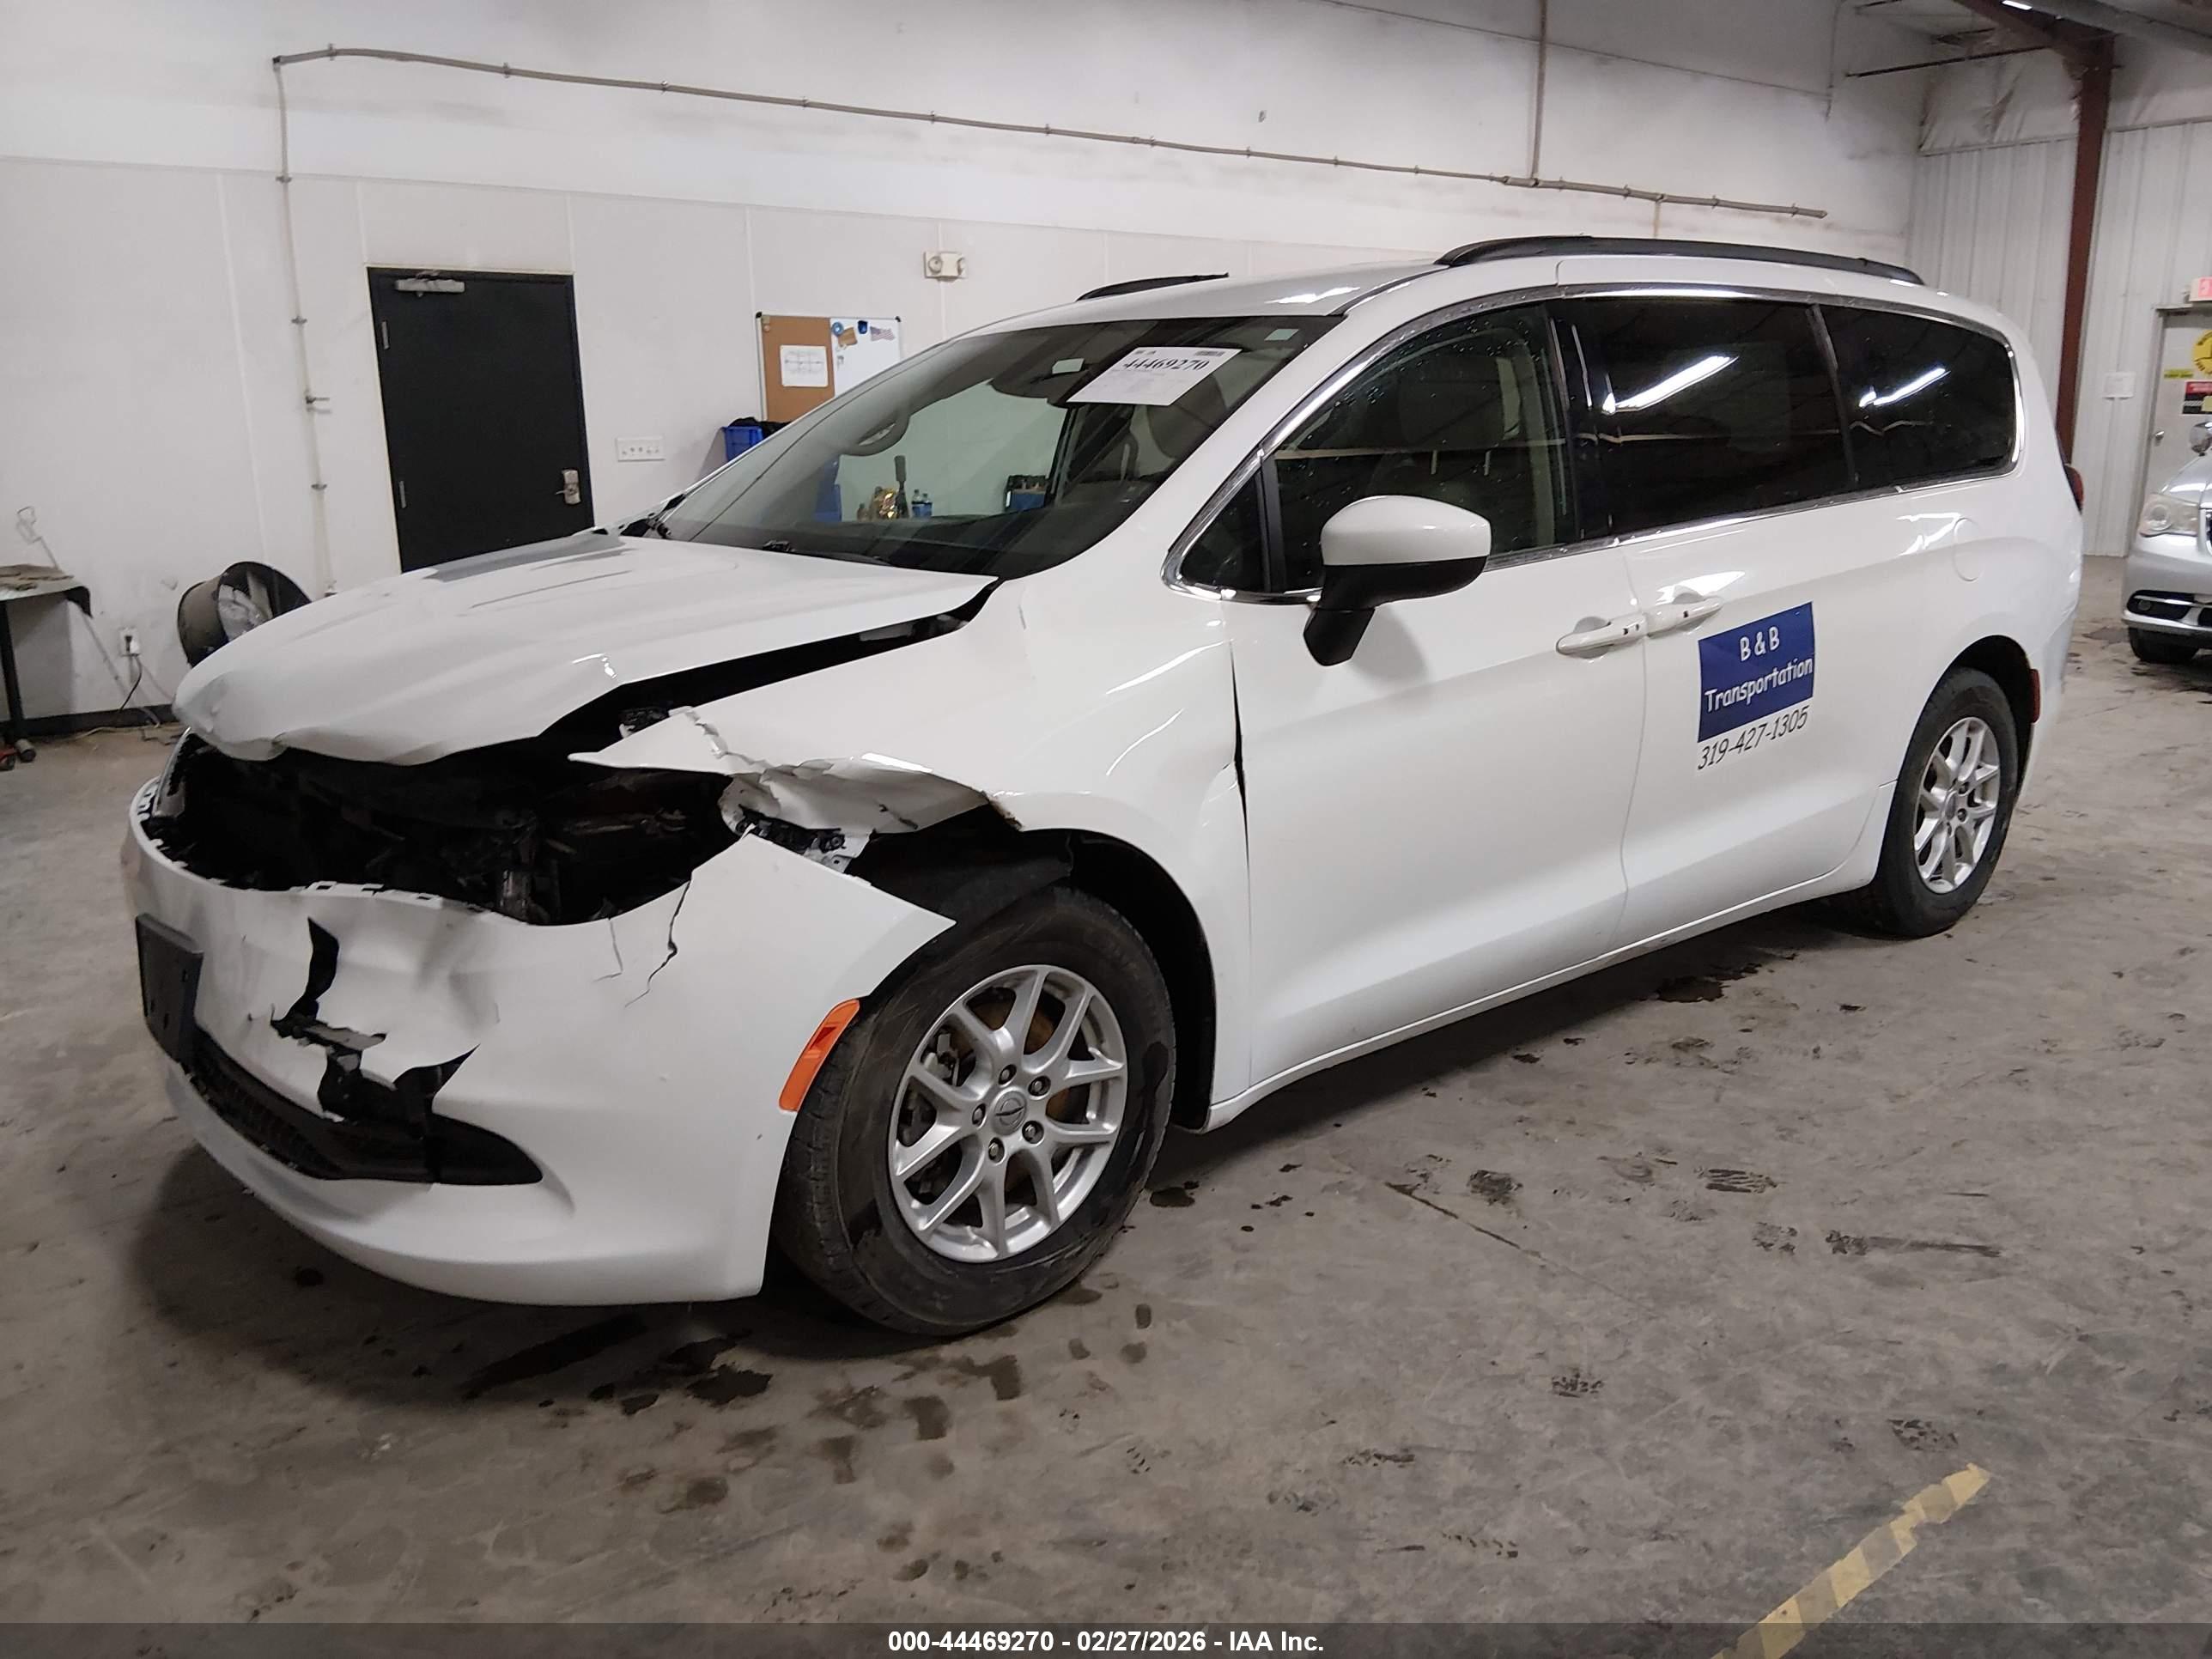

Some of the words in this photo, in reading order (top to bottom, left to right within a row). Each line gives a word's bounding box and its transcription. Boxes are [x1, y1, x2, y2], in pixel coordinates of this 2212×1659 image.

[1123, 358, 1210, 370] 44469270
[1740, 636, 1751, 661] B
[1754, 631, 1765, 655] &
[1769, 626, 1780, 651] B
[1705, 658, 1813, 713] Transportation
[1698, 706, 1809, 769] 319-427-1305
